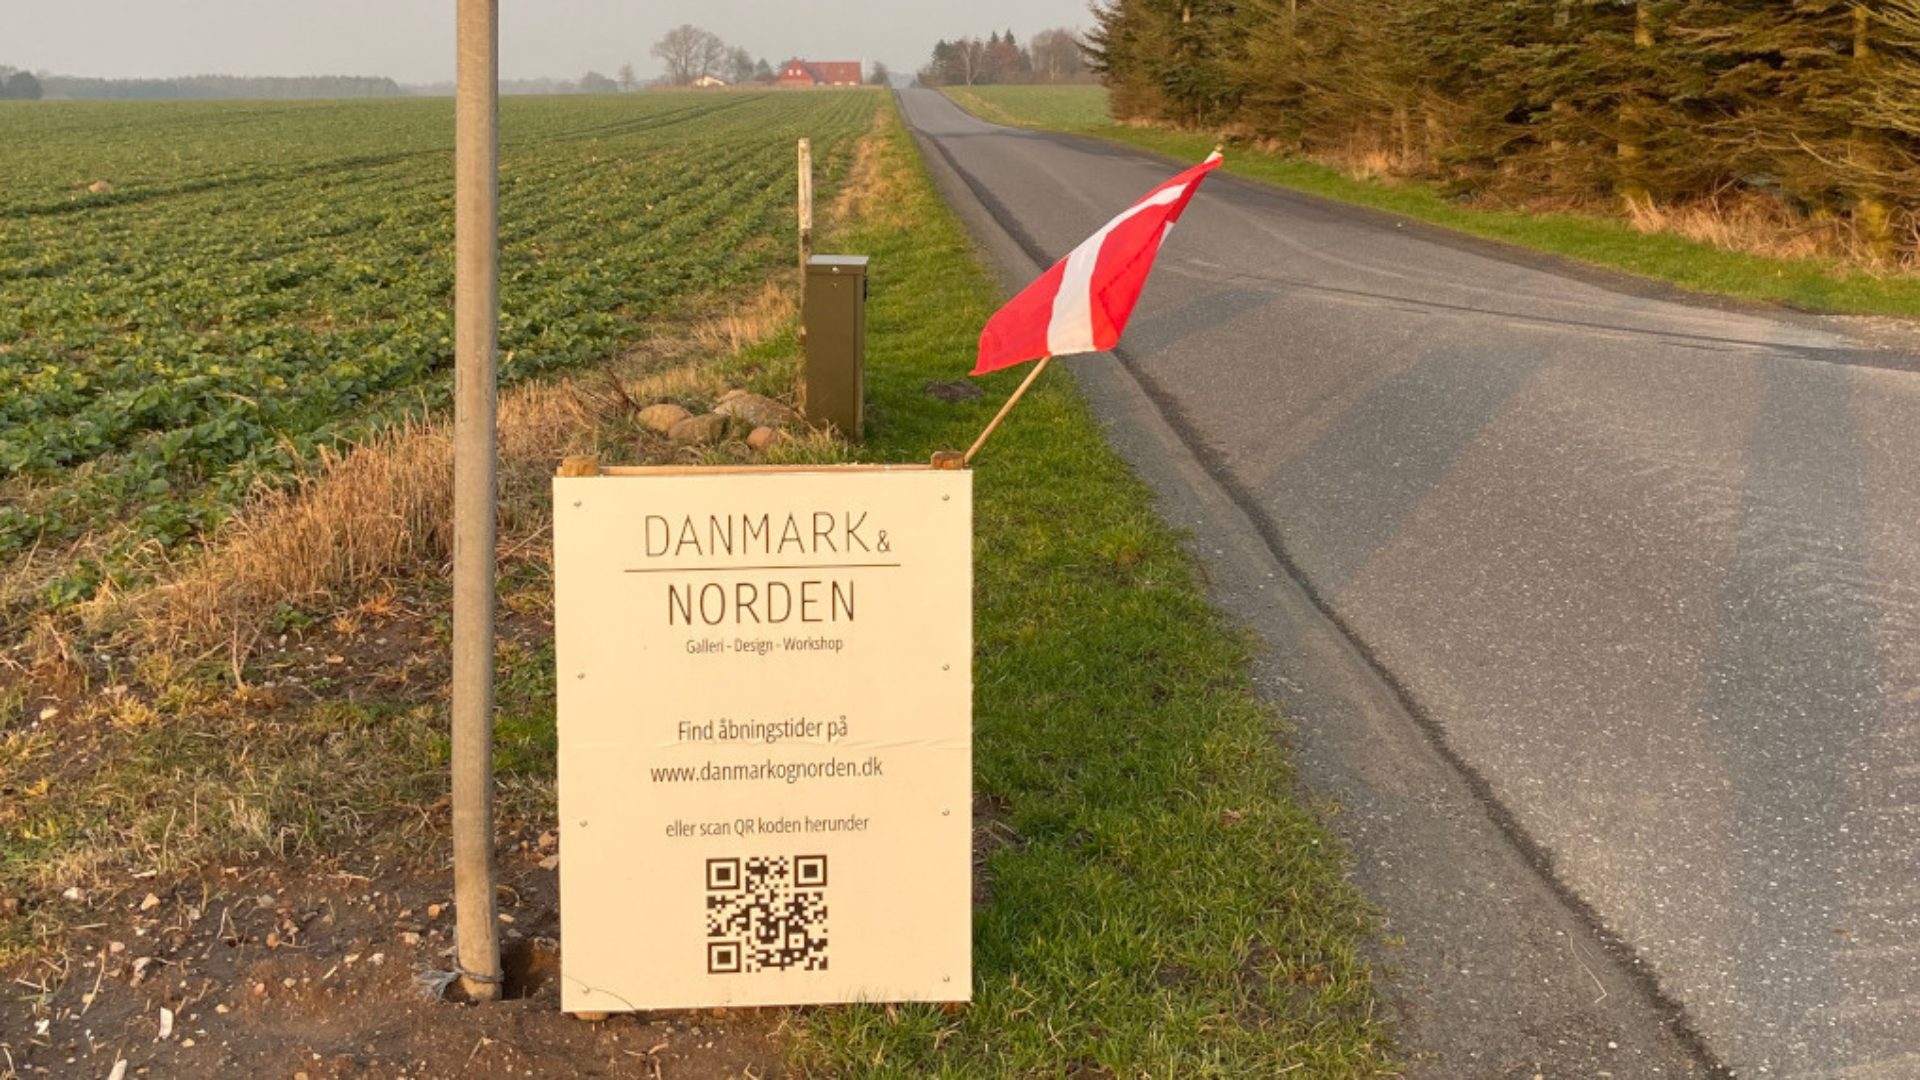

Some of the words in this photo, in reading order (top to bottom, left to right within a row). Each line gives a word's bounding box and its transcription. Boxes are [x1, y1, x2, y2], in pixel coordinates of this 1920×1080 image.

[667, 579, 856, 626] NORDEN
[685, 638, 725, 655] Galleri
[733, 637, 774, 657] Design
[782, 634, 844, 654] Workshop
[677, 719, 714, 742] Find
[717, 715, 824, 745] åbningstider
[826, 714, 849, 743] på
[649, 755, 884, 785] www.danmarkognorden.dk
[664, 819, 697, 838] eller
[699, 820, 731, 837] scan
[733, 818, 755, 837] QR
[757, 816, 802, 835] koden
[804, 814, 870, 834] herunder
